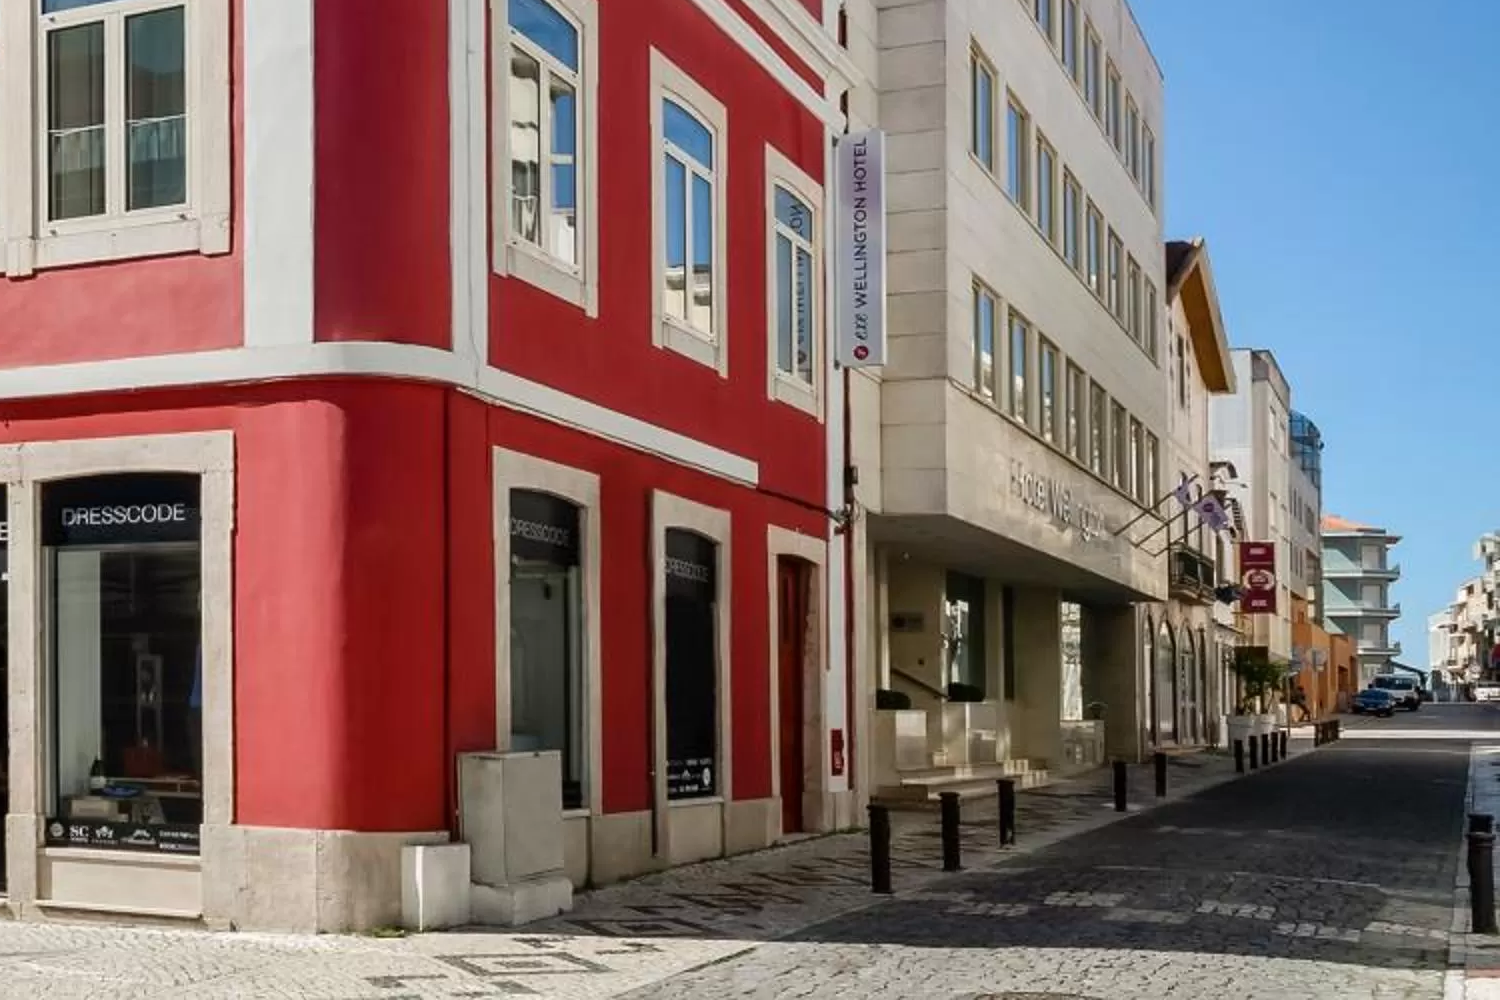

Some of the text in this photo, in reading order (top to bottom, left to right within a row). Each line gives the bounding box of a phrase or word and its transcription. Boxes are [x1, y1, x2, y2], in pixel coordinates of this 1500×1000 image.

[853, 137, 868, 191] HOTEL
[853, 197, 868, 308] WELLINGTON
[62, 503, 186, 527] DRESSCODE
